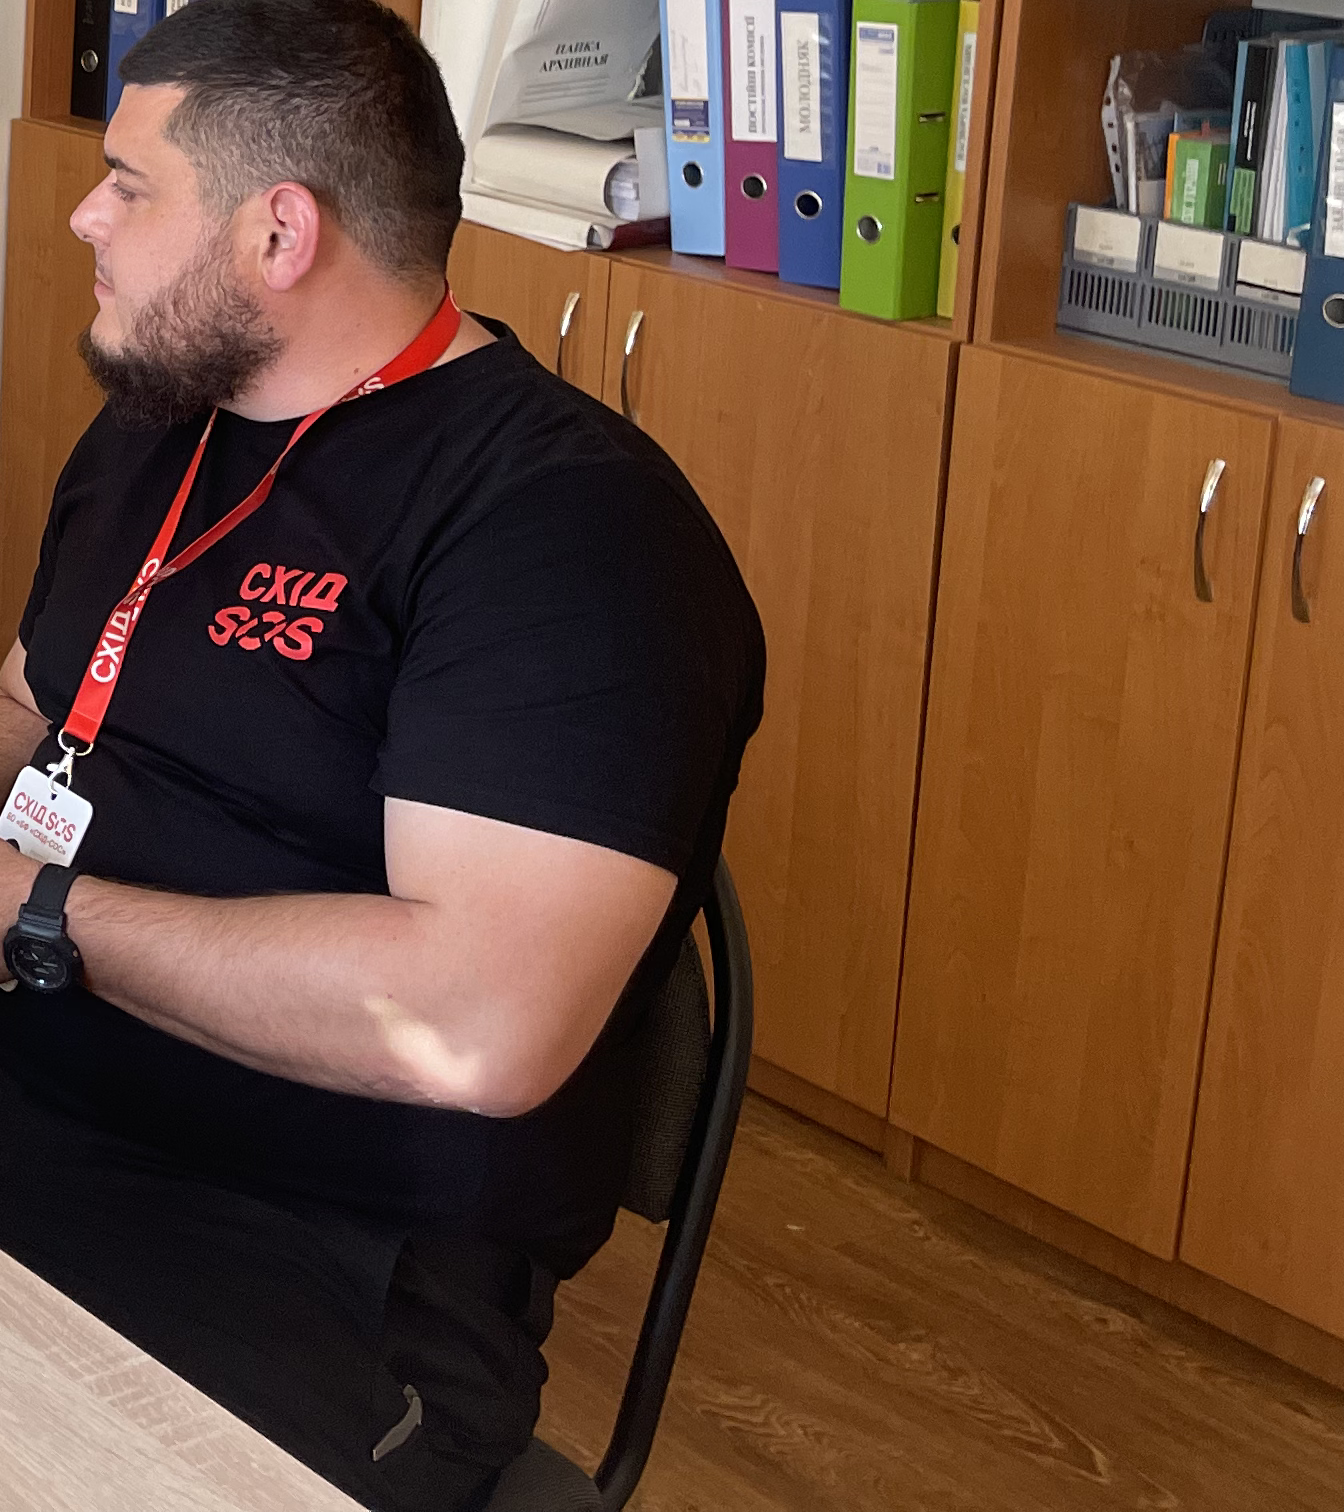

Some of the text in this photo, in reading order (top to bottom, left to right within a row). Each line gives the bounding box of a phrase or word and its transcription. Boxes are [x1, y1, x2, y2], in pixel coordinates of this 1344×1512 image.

[555, 40, 601, 55] ПАПКА
[239, 562, 349, 613] СХІД
[91, 610, 131, 683] СХІД
[208, 605, 324, 661] SOS
[14, 792, 76, 843] СХІД SOS
